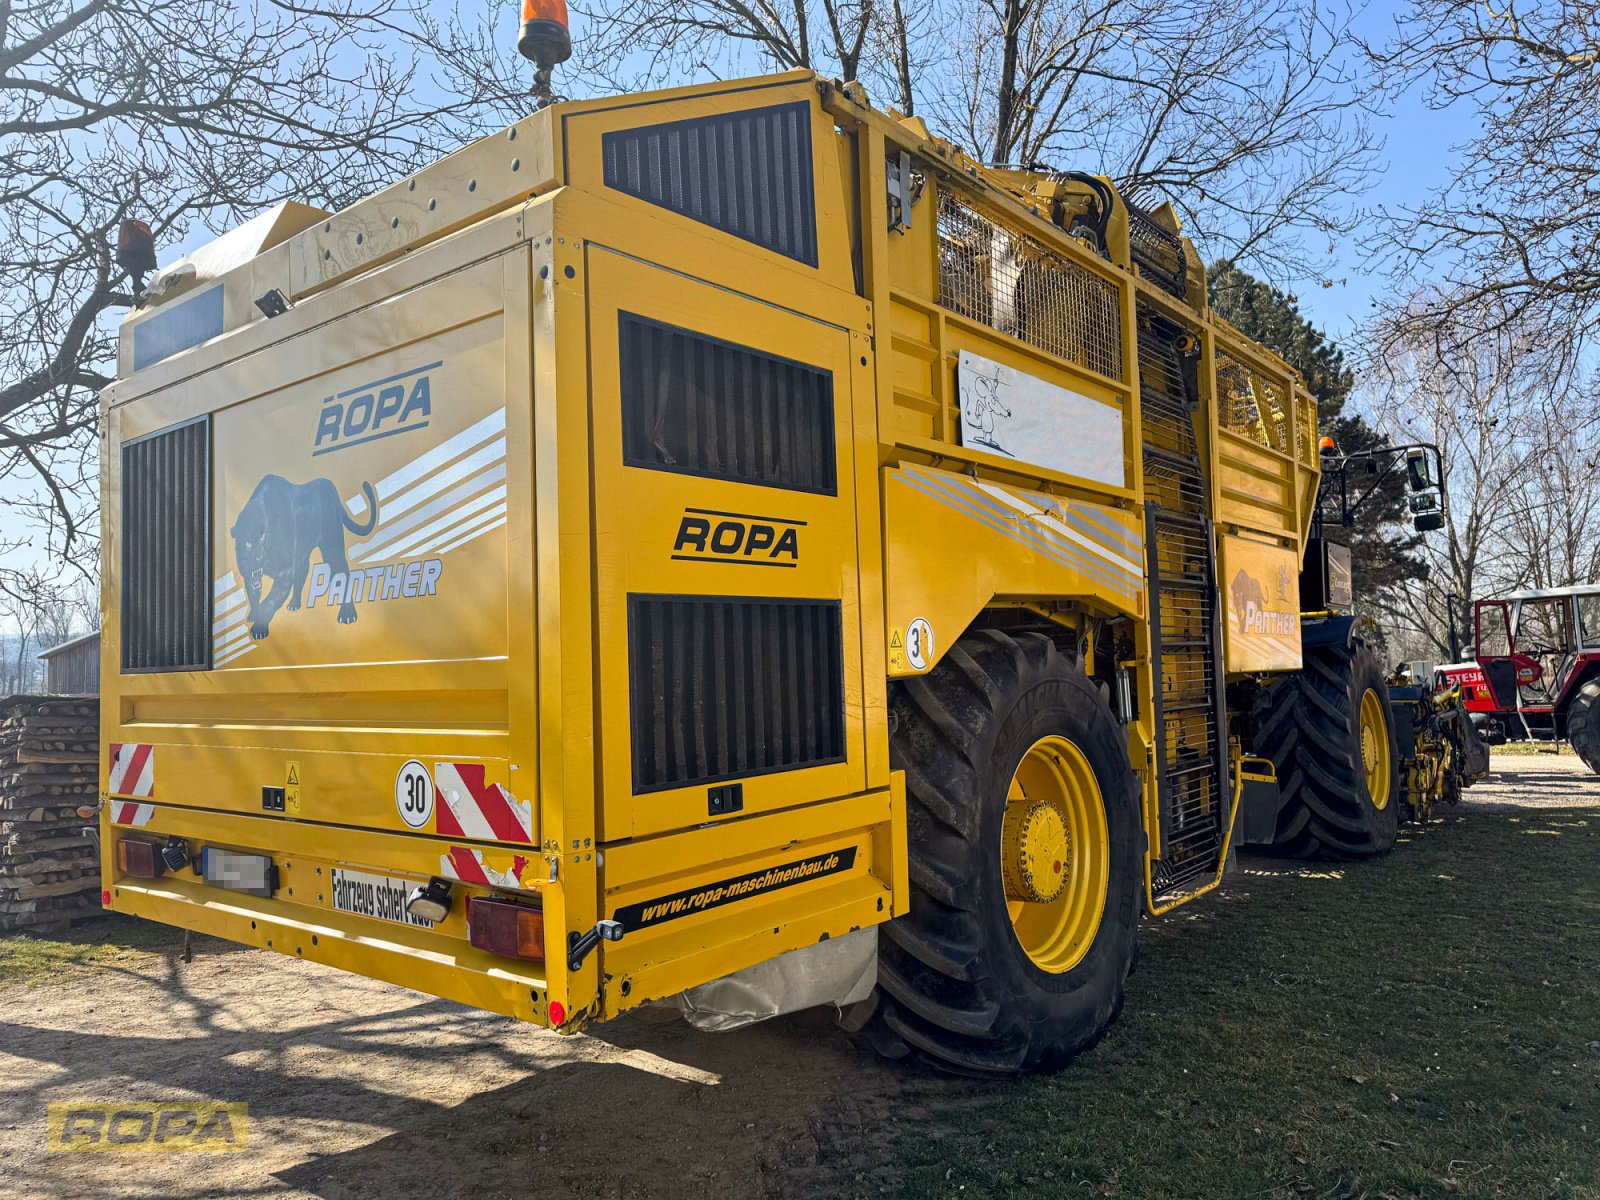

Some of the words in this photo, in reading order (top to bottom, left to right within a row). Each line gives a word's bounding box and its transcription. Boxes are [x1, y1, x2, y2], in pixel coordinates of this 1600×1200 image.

[315, 376, 431, 446] ROPA
[673, 516, 798, 559] ROPA
[306, 559, 442, 608] PANTHER
[1245, 600, 1296, 636] PANTHER
[405, 774, 425, 813] 30
[331, 868, 375, 916] Fahrzeug
[376, 877, 409, 923] schert
[641, 854, 839, 922] www.ropa-maschinenbau.de
